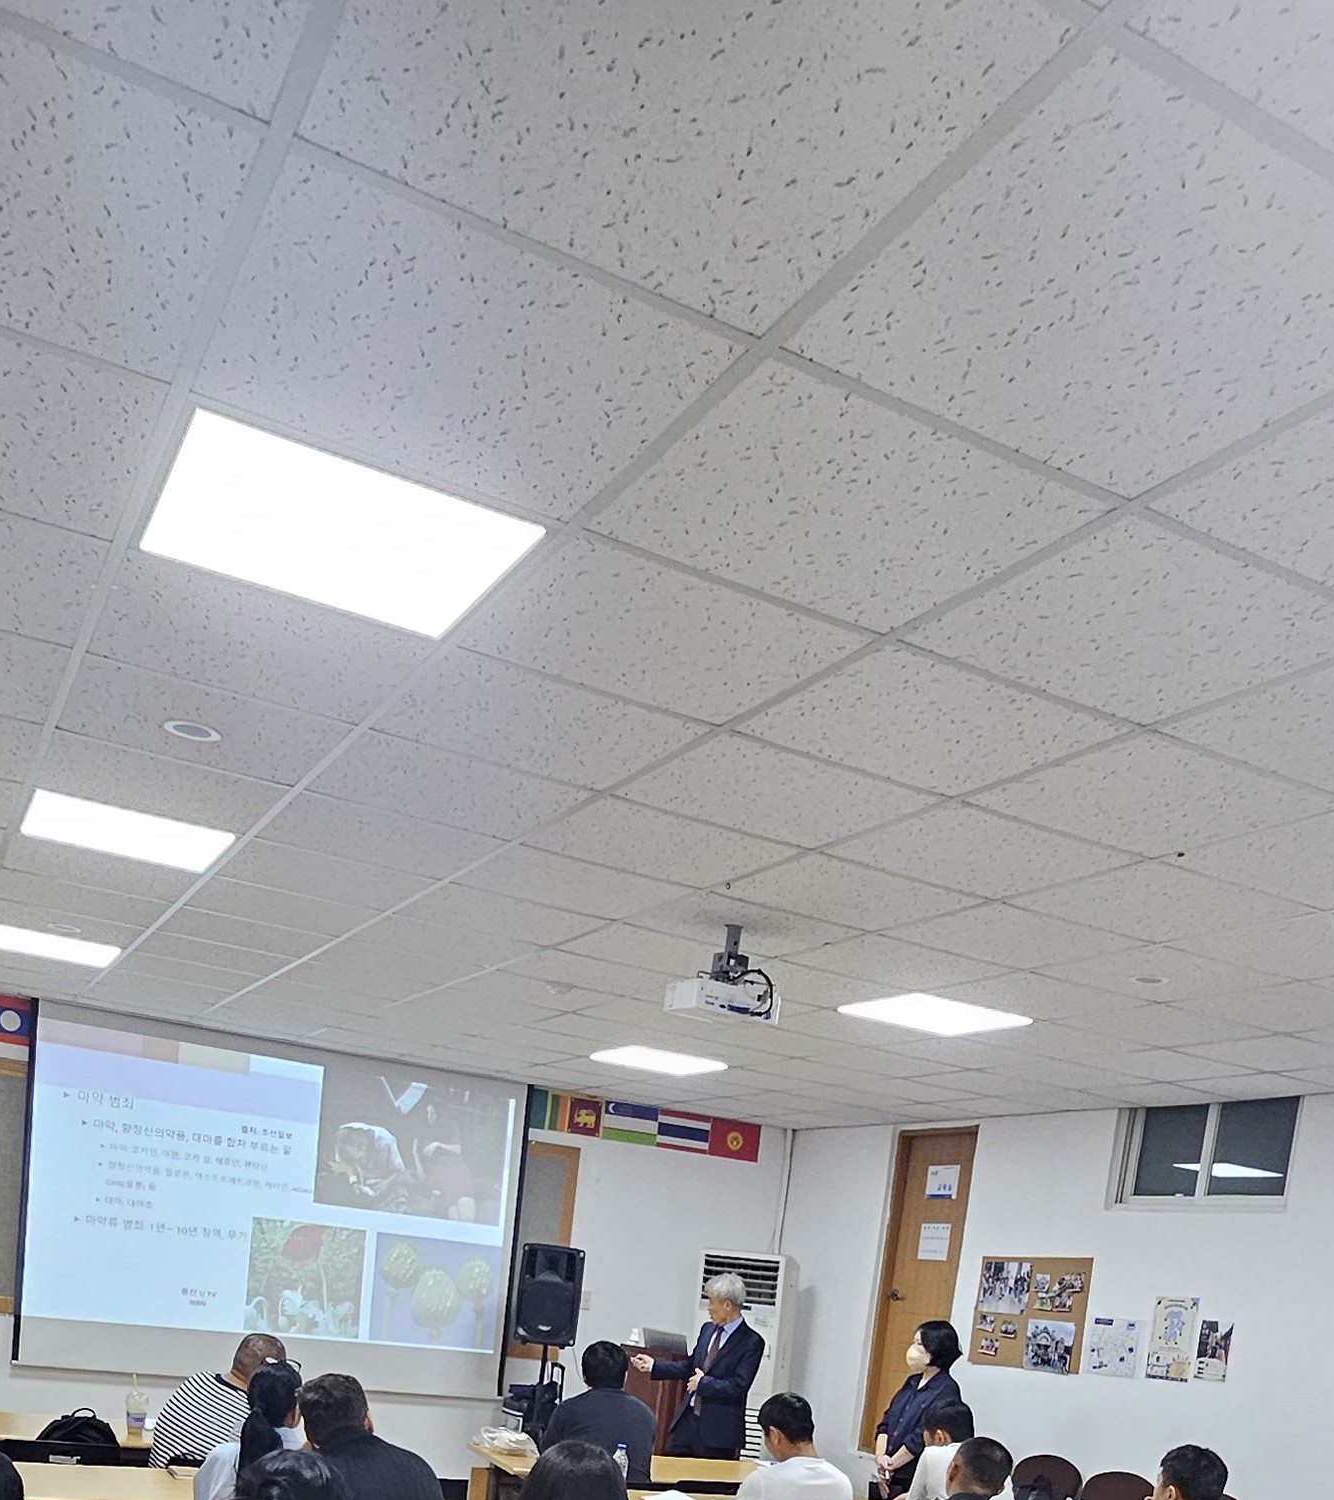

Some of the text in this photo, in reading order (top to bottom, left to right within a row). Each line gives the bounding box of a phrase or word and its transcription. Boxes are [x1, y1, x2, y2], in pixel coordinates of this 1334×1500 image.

[78, 1089, 135, 1110] 마약 범죄
[93, 1118, 118, 1133] 마약,
[122, 1123, 189, 1143] 향정신의약품,
[192, 1132, 222, 1146] 대마를
[250, 1141, 278, 1154] 부르는
[86, 1215, 117, 1228] 마약류
[177, 1226, 197, 1237] 10년
